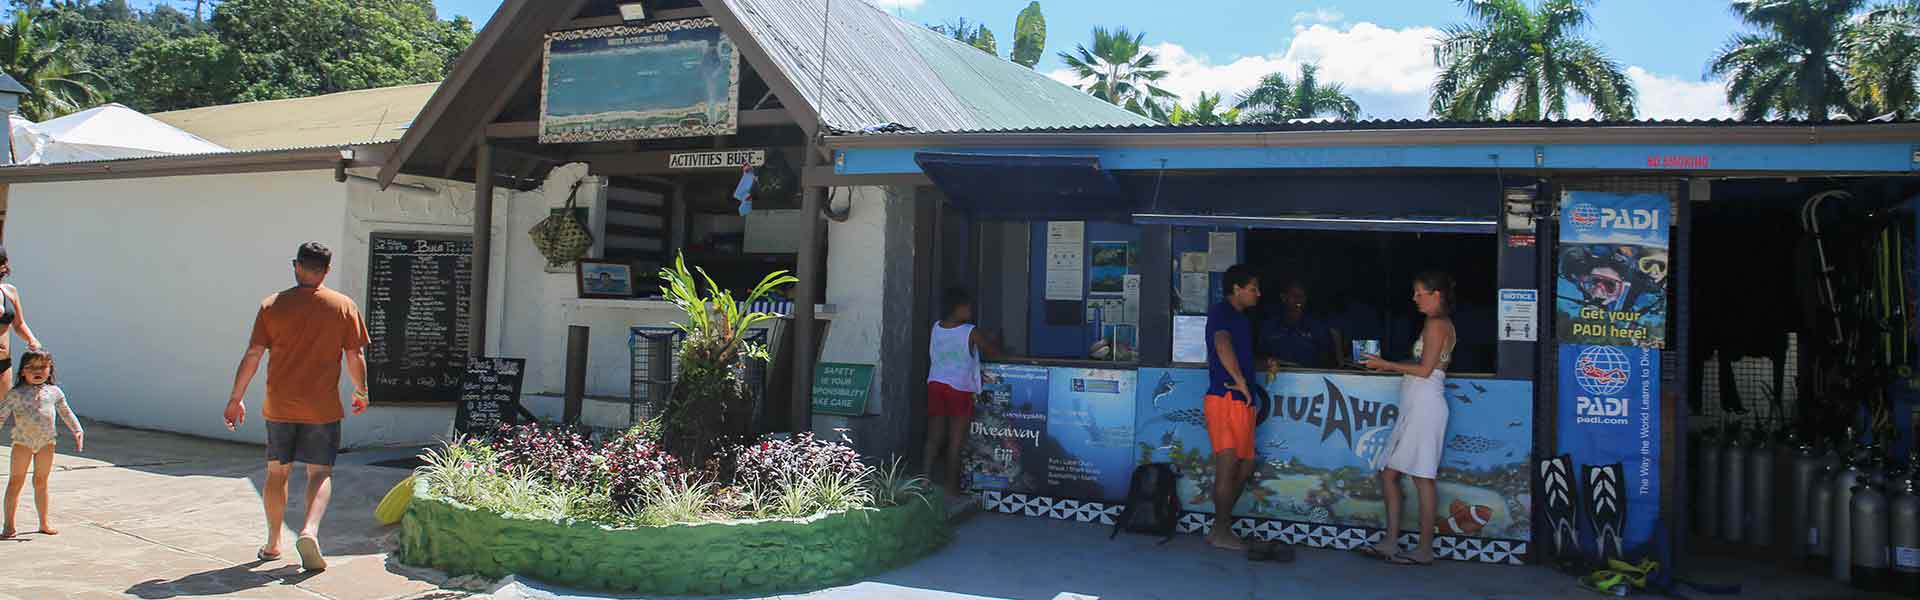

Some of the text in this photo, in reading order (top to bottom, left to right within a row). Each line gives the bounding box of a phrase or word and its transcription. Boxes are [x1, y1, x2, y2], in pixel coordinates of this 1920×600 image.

[671, 153, 722, 167] ACTIVITIES
[1664, 155, 1709, 168] SMOKING
[1600, 207, 1659, 230] PADI
[1581, 307, 1641, 323] Get your
[1573, 323, 1648, 339] PADI here!
[824, 367, 856, 376] SAFETY
[1640, 368, 1650, 379] to
[831, 377, 852, 385] YOUR
[814, 398, 853, 408] AKE CARE
[1639, 381, 1650, 410] Learns
[1256, 376, 1399, 450] DIVEAWA
[1576, 396, 1629, 416] PADI
[1576, 416, 1629, 425] padi.com
[1639, 411, 1650, 438] World
[970, 421, 1041, 447] Diveaway
[1639, 440, 1650, 455] the
[994, 447, 1013, 469] Fiji
[1639, 457, 1650, 477] Way
[1639, 479, 1649, 495] This
